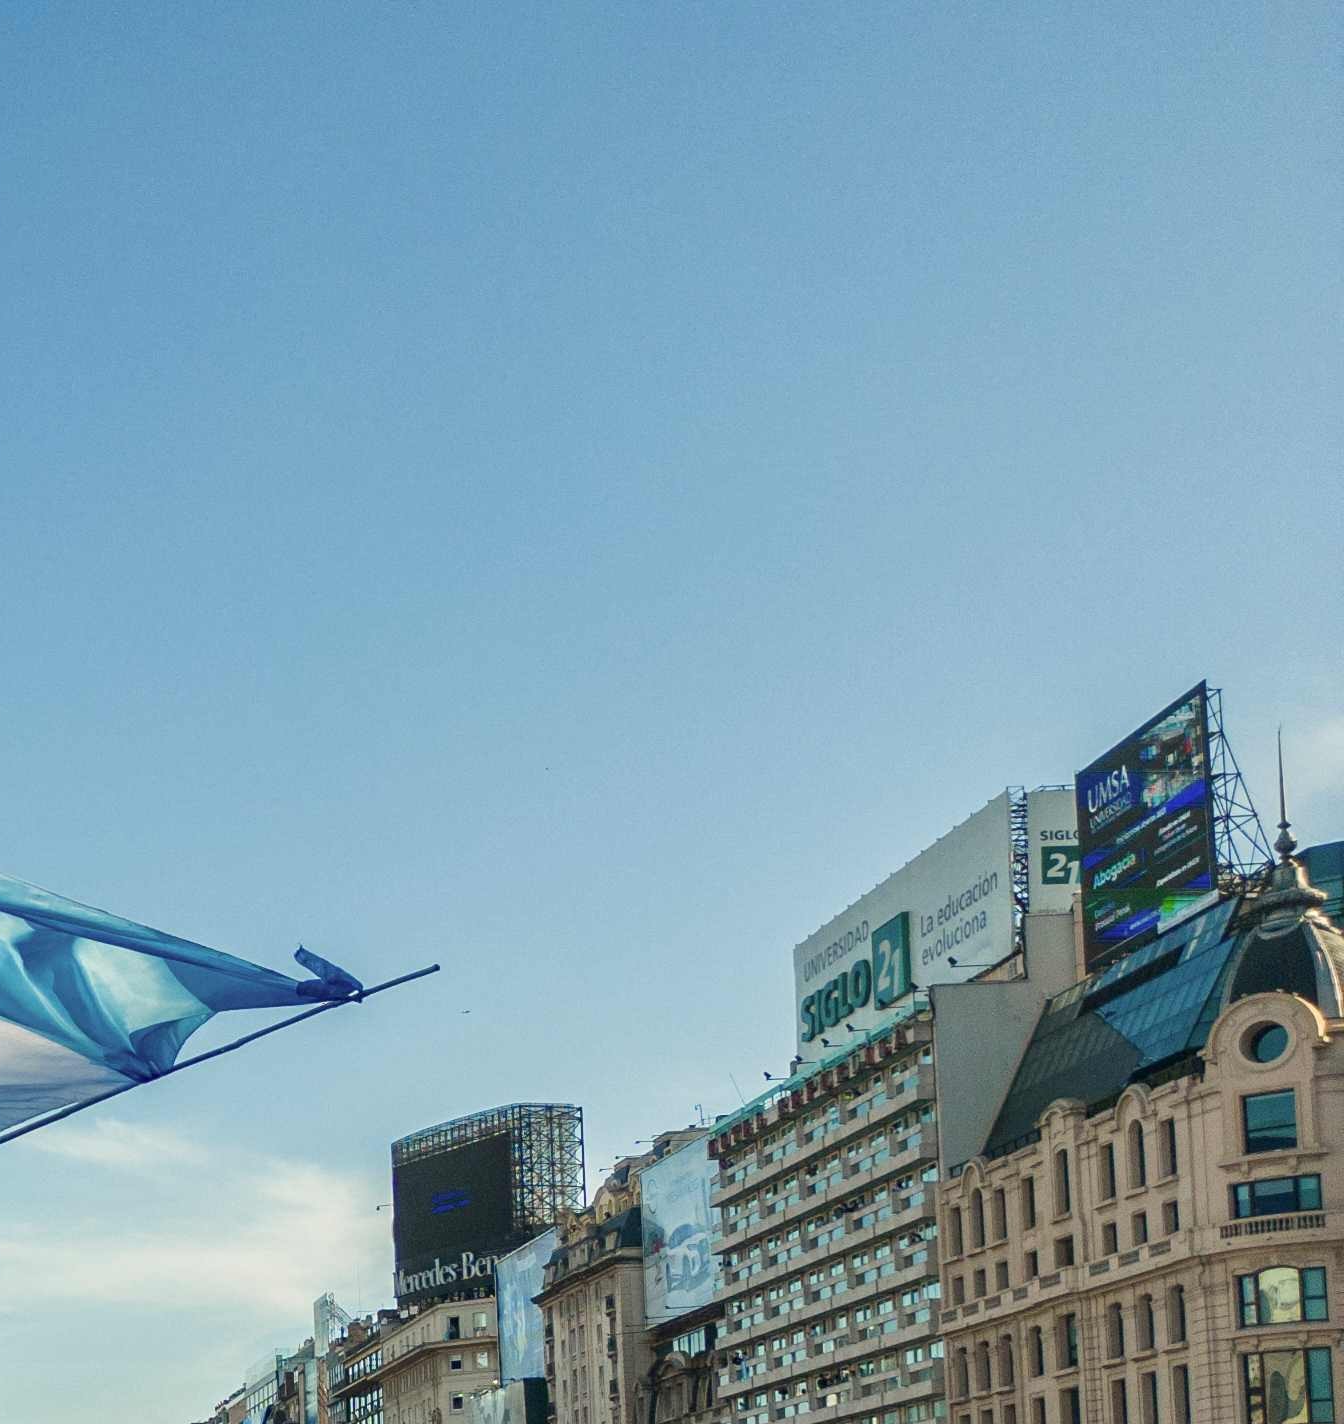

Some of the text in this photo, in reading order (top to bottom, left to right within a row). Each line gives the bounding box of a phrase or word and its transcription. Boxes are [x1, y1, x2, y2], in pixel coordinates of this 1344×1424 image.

[1087, 765, 1130, 813] UMSA
[920, 871, 998, 938] La educación
[802, 920, 869, 982] UNIVERSIDAD
[922, 910, 987, 966] evoluciona
[801, 940, 900, 1042] SIGLO 21
[399, 1251, 500, 1294] Mercedes-Ben
